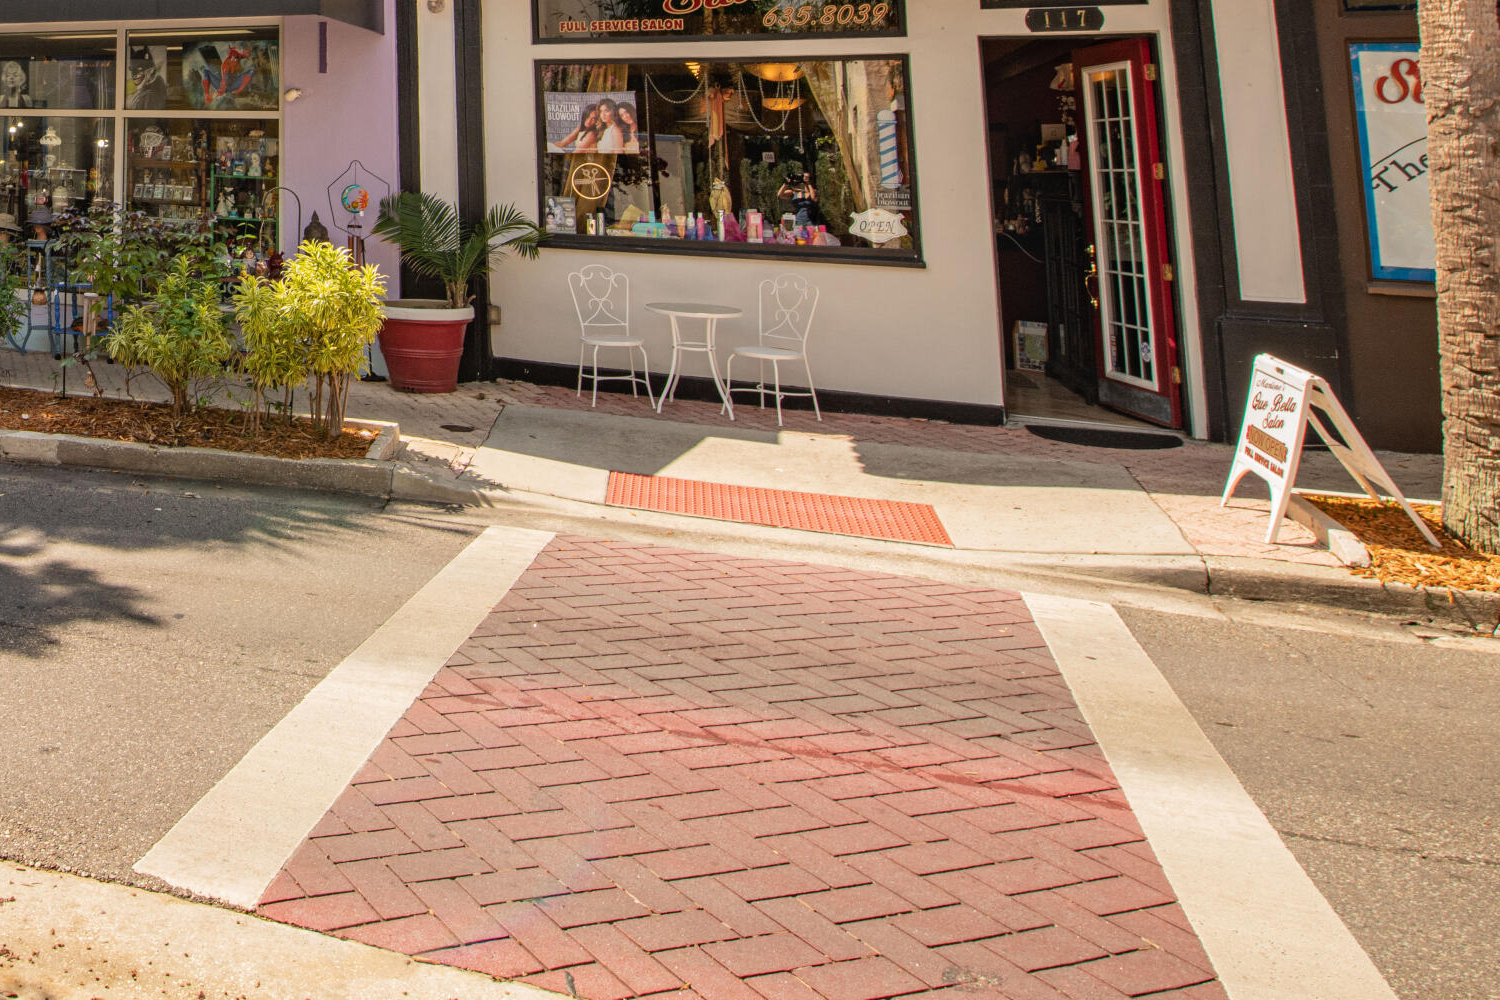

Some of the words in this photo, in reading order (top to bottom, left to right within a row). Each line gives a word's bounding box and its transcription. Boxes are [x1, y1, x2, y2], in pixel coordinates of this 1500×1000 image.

[763, 3, 889, 27] 635.8039
[1044, 9, 1086, 28] 117
[559, 21, 588, 32] FULL
[590, 20, 639, 32] SERVICE
[641, 18, 684, 31] SALON
[547, 103, 580, 113] BRAZILIAN
[547, 112, 580, 121] BLOWOUT
[860, 220, 896, 235] OPEN
[1252, 391, 1268, 411] Que
[1271, 393, 1297, 413] Bella
[1262, 412, 1284, 429] Salon
[1265, 437, 1285, 462] OPEN
